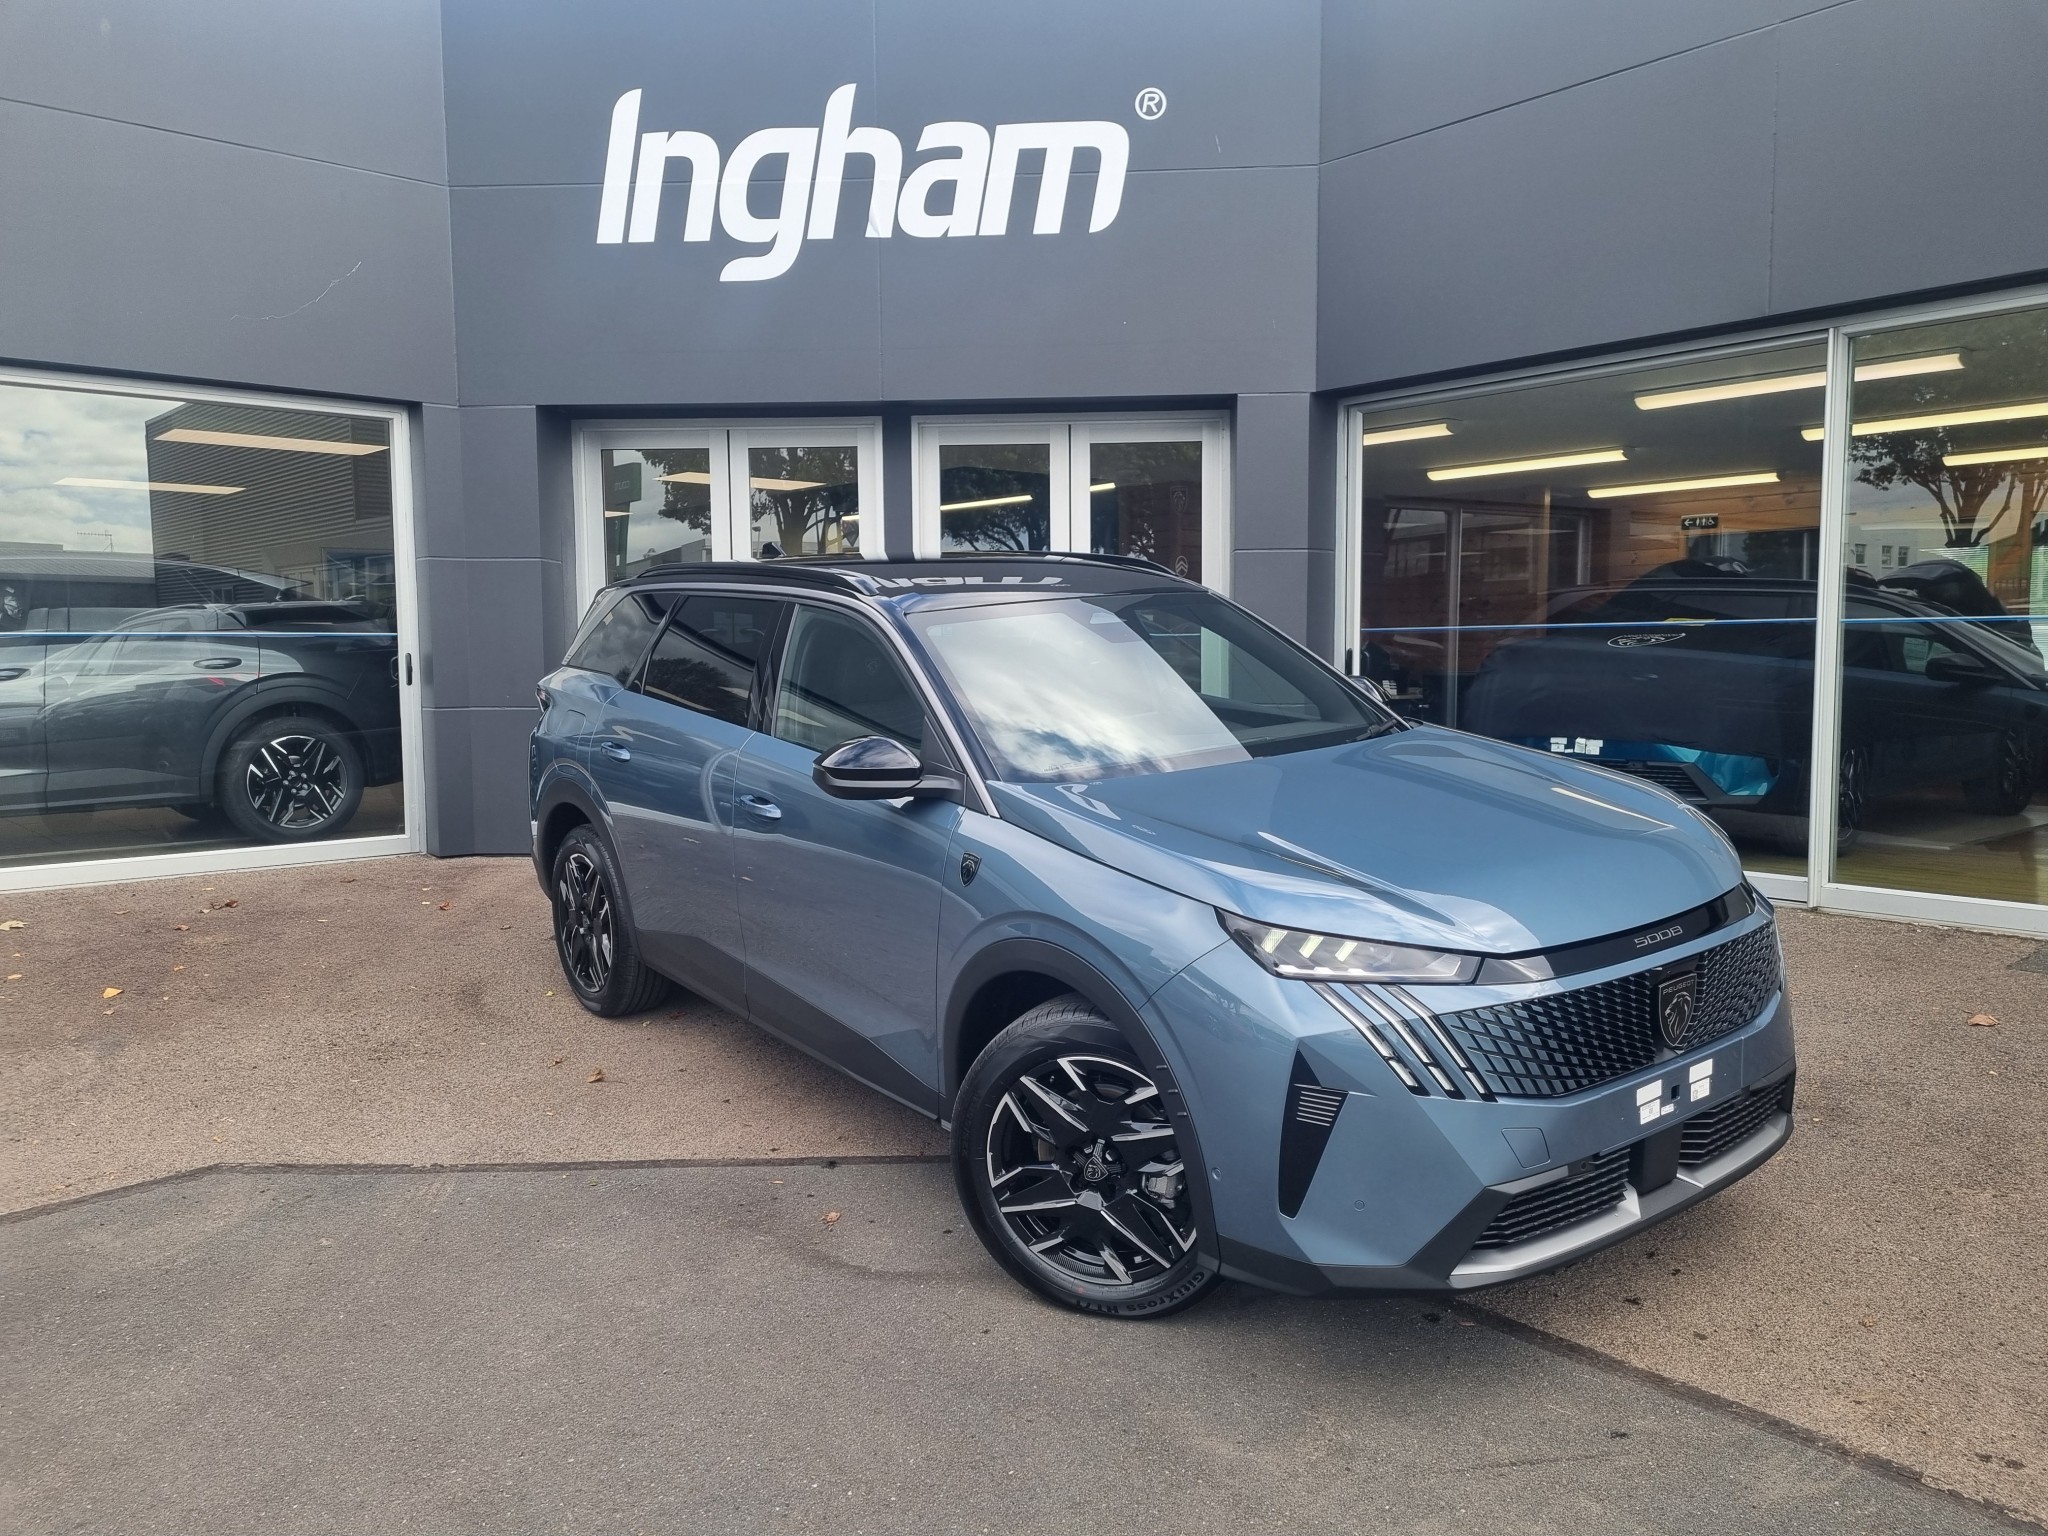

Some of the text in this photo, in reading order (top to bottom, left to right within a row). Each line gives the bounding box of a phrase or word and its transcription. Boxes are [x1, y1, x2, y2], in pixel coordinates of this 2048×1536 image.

[596, 83, 1130, 282] Ingham
[1634, 925, 1683, 949] 5008
[1662, 979, 1695, 996] PEUGEOT
